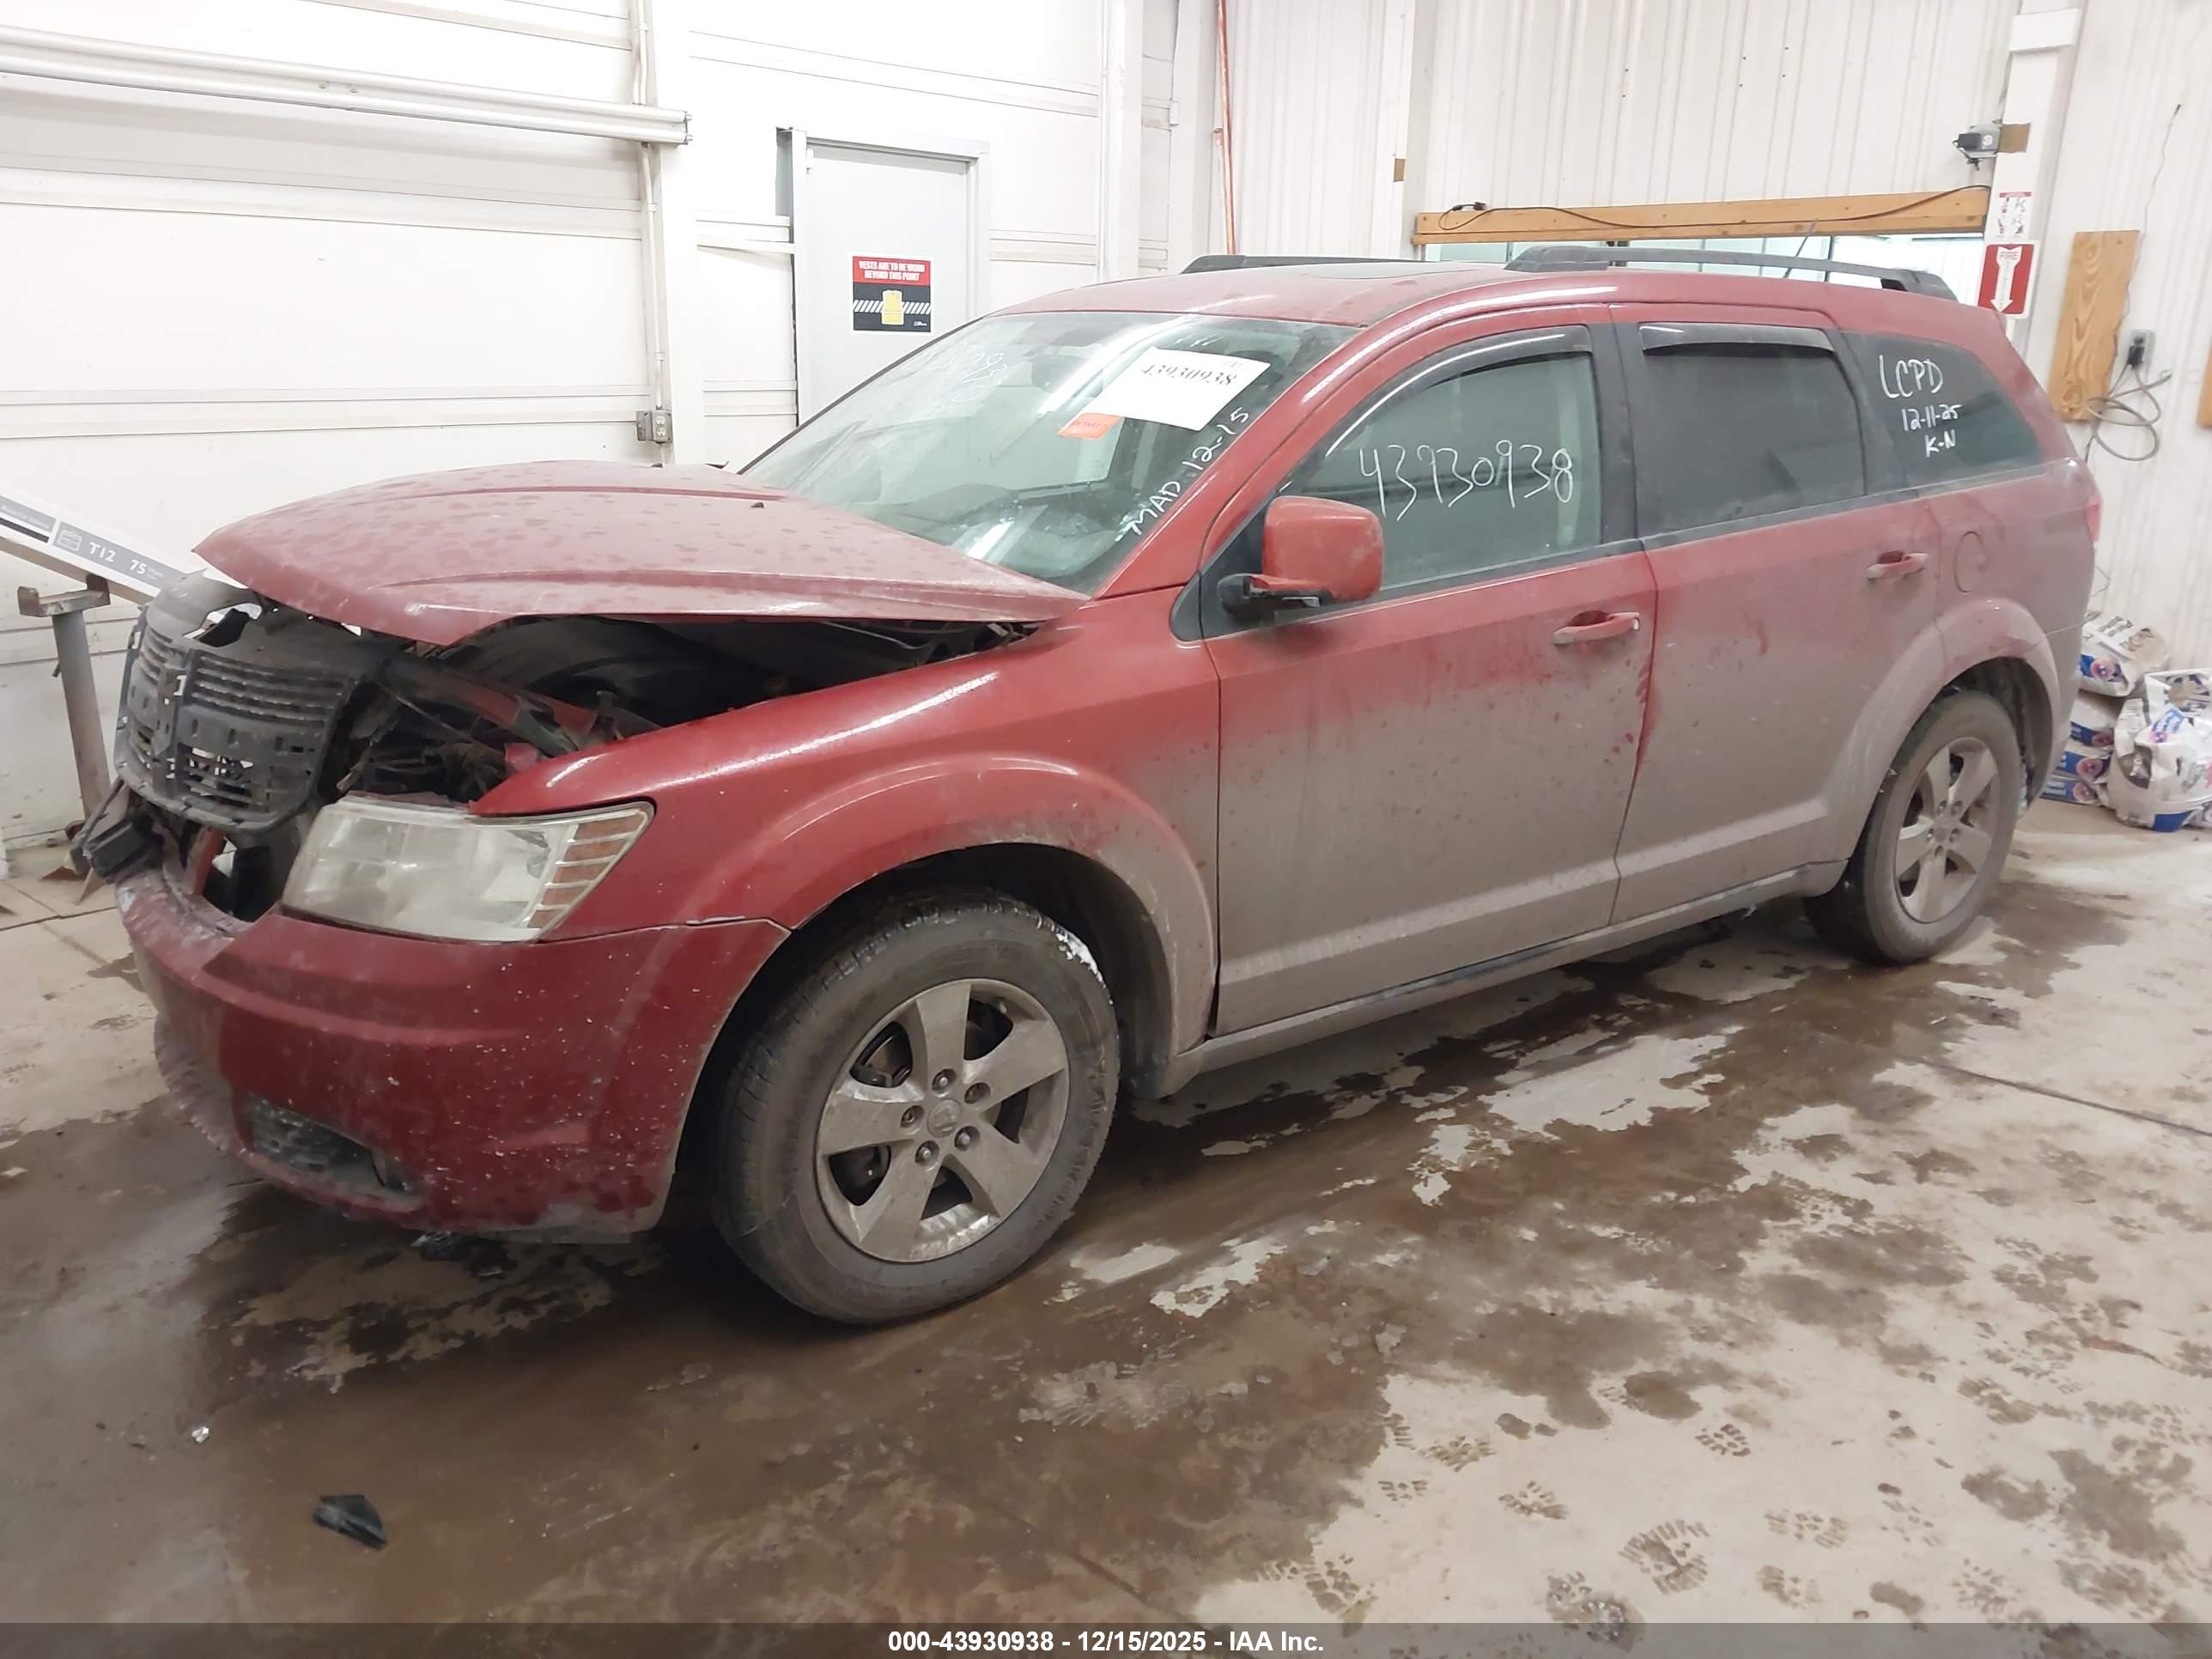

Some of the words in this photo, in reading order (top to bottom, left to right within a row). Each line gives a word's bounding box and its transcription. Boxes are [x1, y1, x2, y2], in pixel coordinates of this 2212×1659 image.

[1878, 354, 1944, 398] LCPD
[1901, 404, 1963, 432] 12-11-25
[1182, 406, 1249, 471] 12-15
[1924, 428, 1956, 458] K-N
[88, 541, 117, 562] T12
[130, 559, 148, 575] 75
